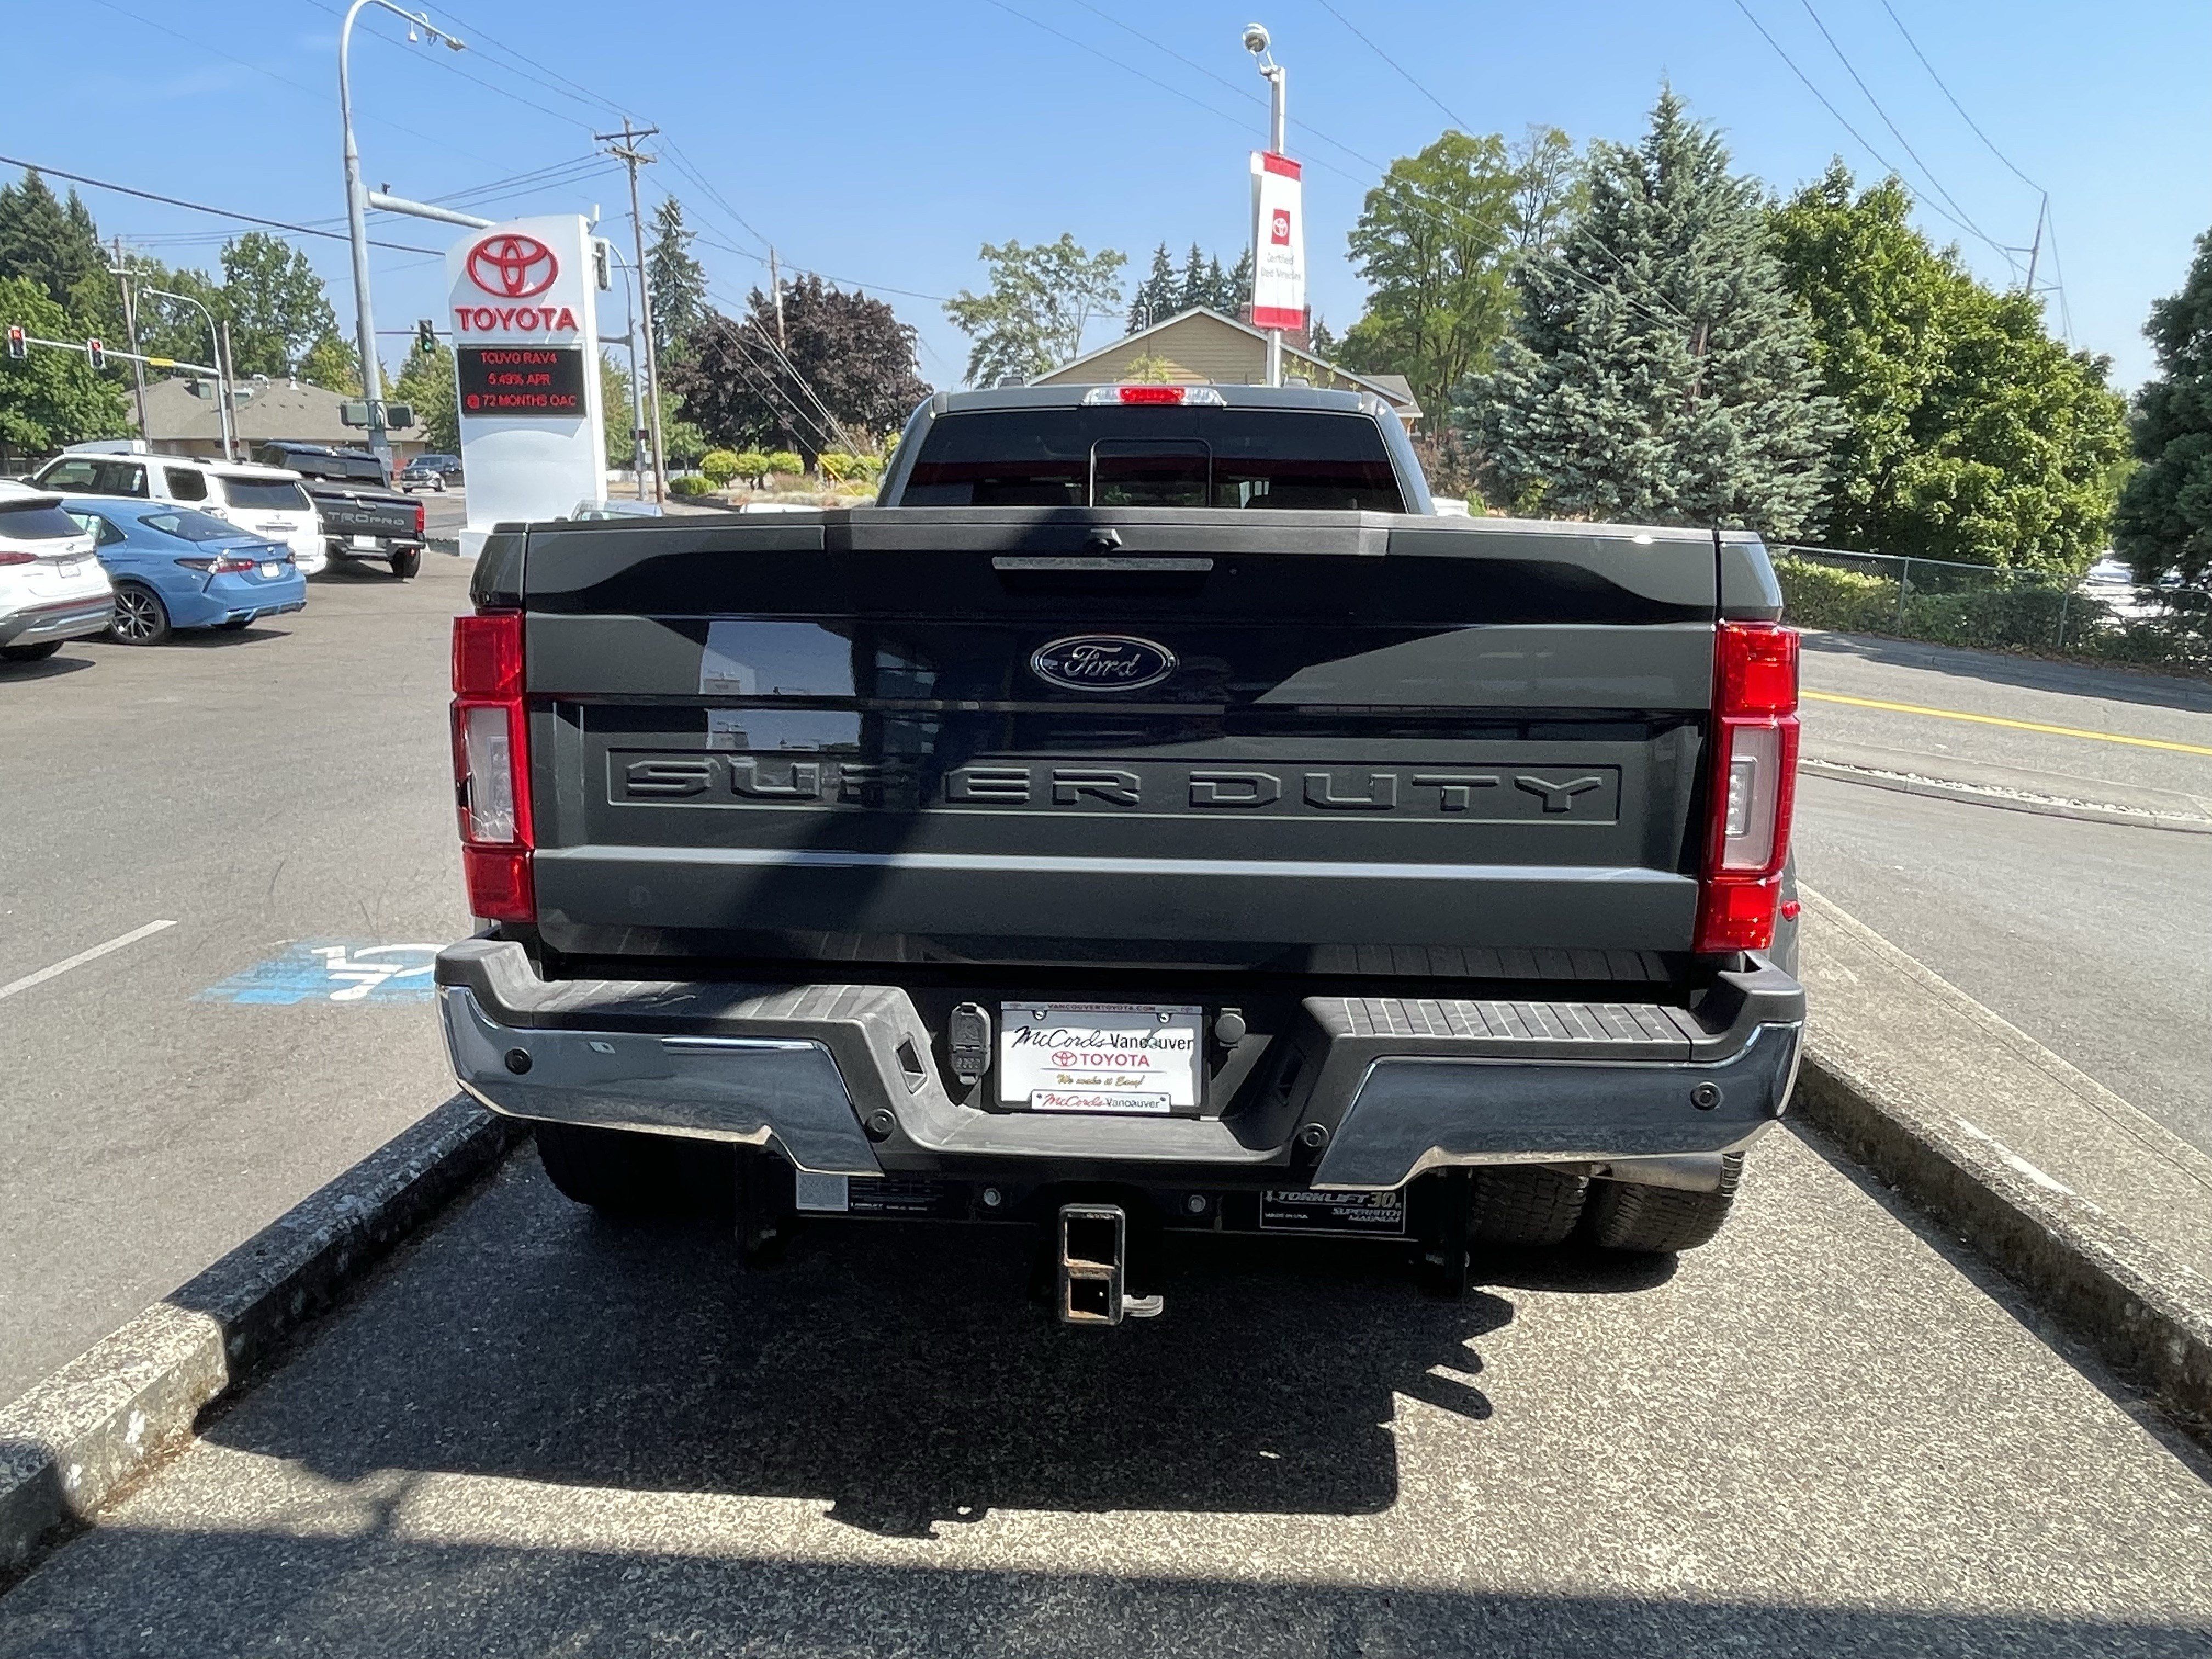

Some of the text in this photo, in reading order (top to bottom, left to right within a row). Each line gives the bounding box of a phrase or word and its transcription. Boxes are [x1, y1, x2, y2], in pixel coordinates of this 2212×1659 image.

[455, 308, 579, 332] TOYOTA
[522, 352, 557, 364] RAV4
[527, 373, 551, 386] APR
[482, 394, 496, 407] 72
[498, 394, 548, 407] MONTHS
[550, 394, 576, 407] OAC
[327, 511, 405, 526] TRD PRO
[1064, 645, 1141, 677] Ford
[626, 755, 1602, 812] SUPER DUTY
[1047, 1003, 1156, 1012] VANCOUVERTOYOTA.COM
[1011, 1025, 1194, 1050] McCords Vancouver
[1080, 1053, 1150, 1067] TOYOTA
[1042, 1093, 1160, 1108] McCords Vancouver
[1278, 1191, 1370, 1204] TORKLIFT
